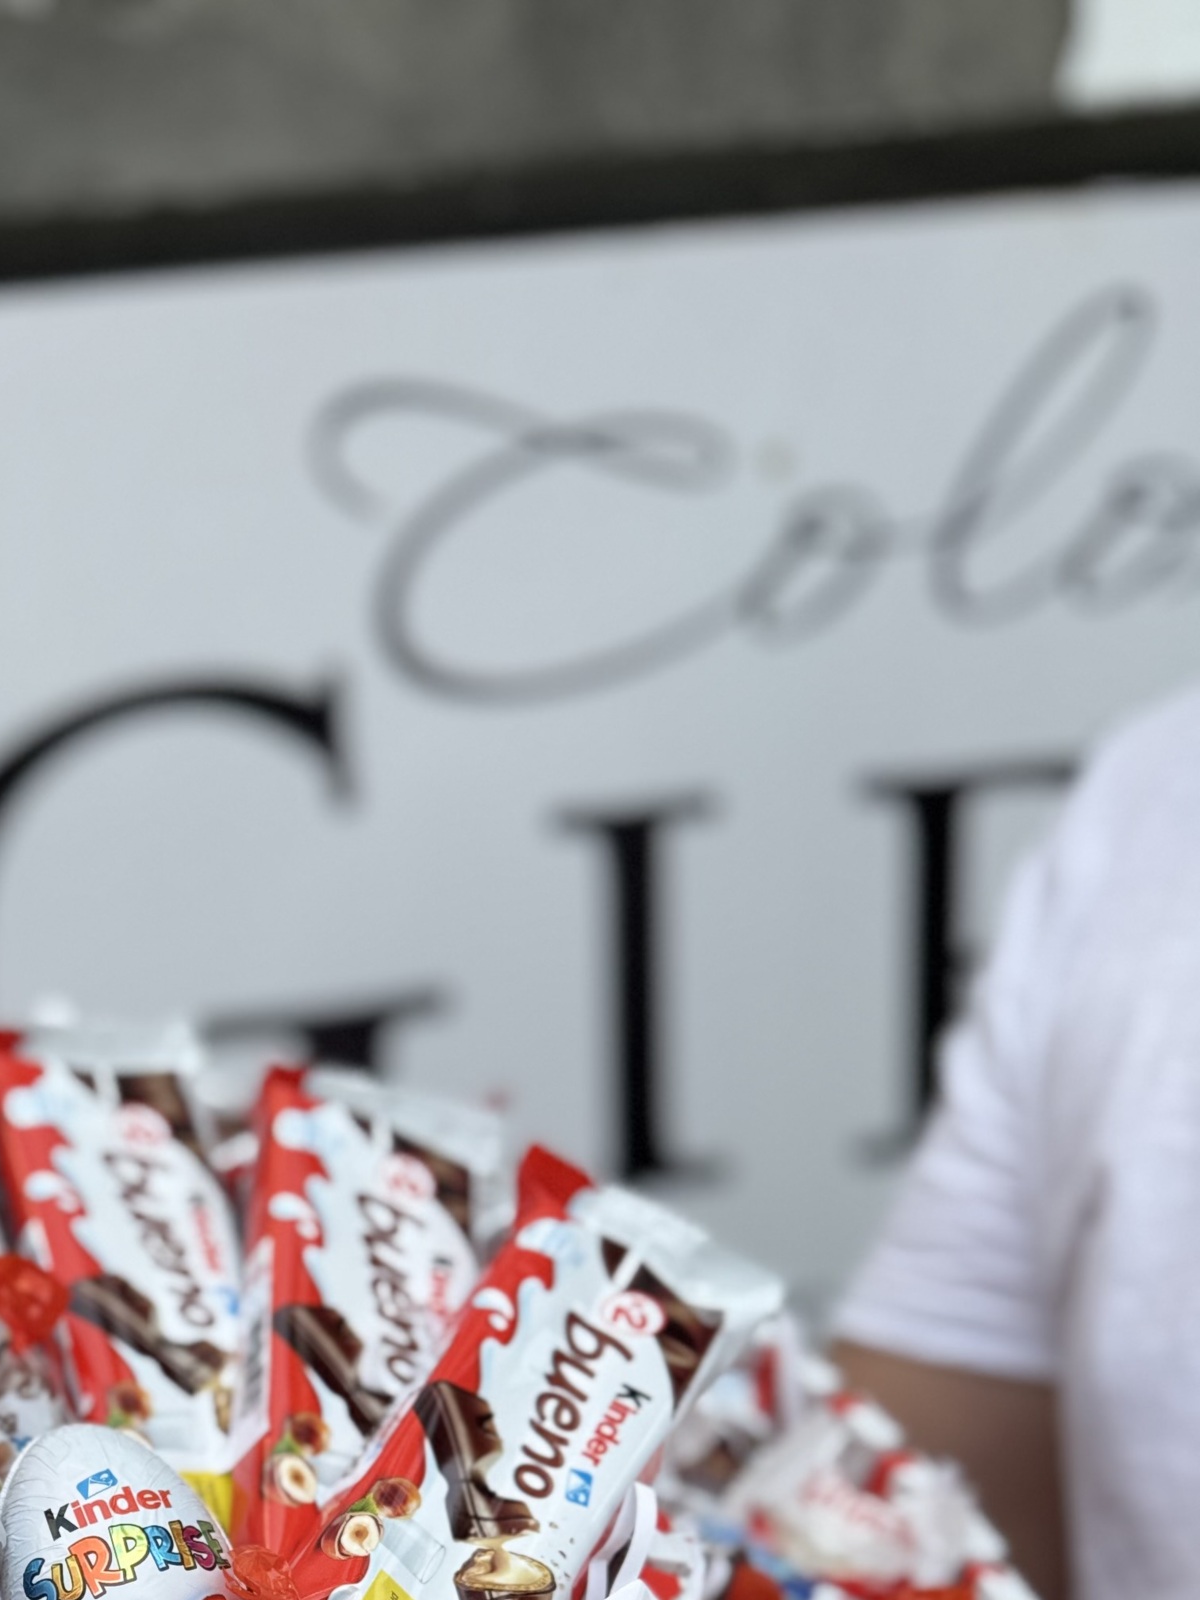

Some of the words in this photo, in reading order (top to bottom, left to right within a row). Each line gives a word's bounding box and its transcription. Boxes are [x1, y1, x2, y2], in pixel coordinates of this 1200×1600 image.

[512, 1311, 636, 1502] bueno
[583, 1382, 652, 1467] Kinder
[44, 1482, 172, 1542] Kinder
